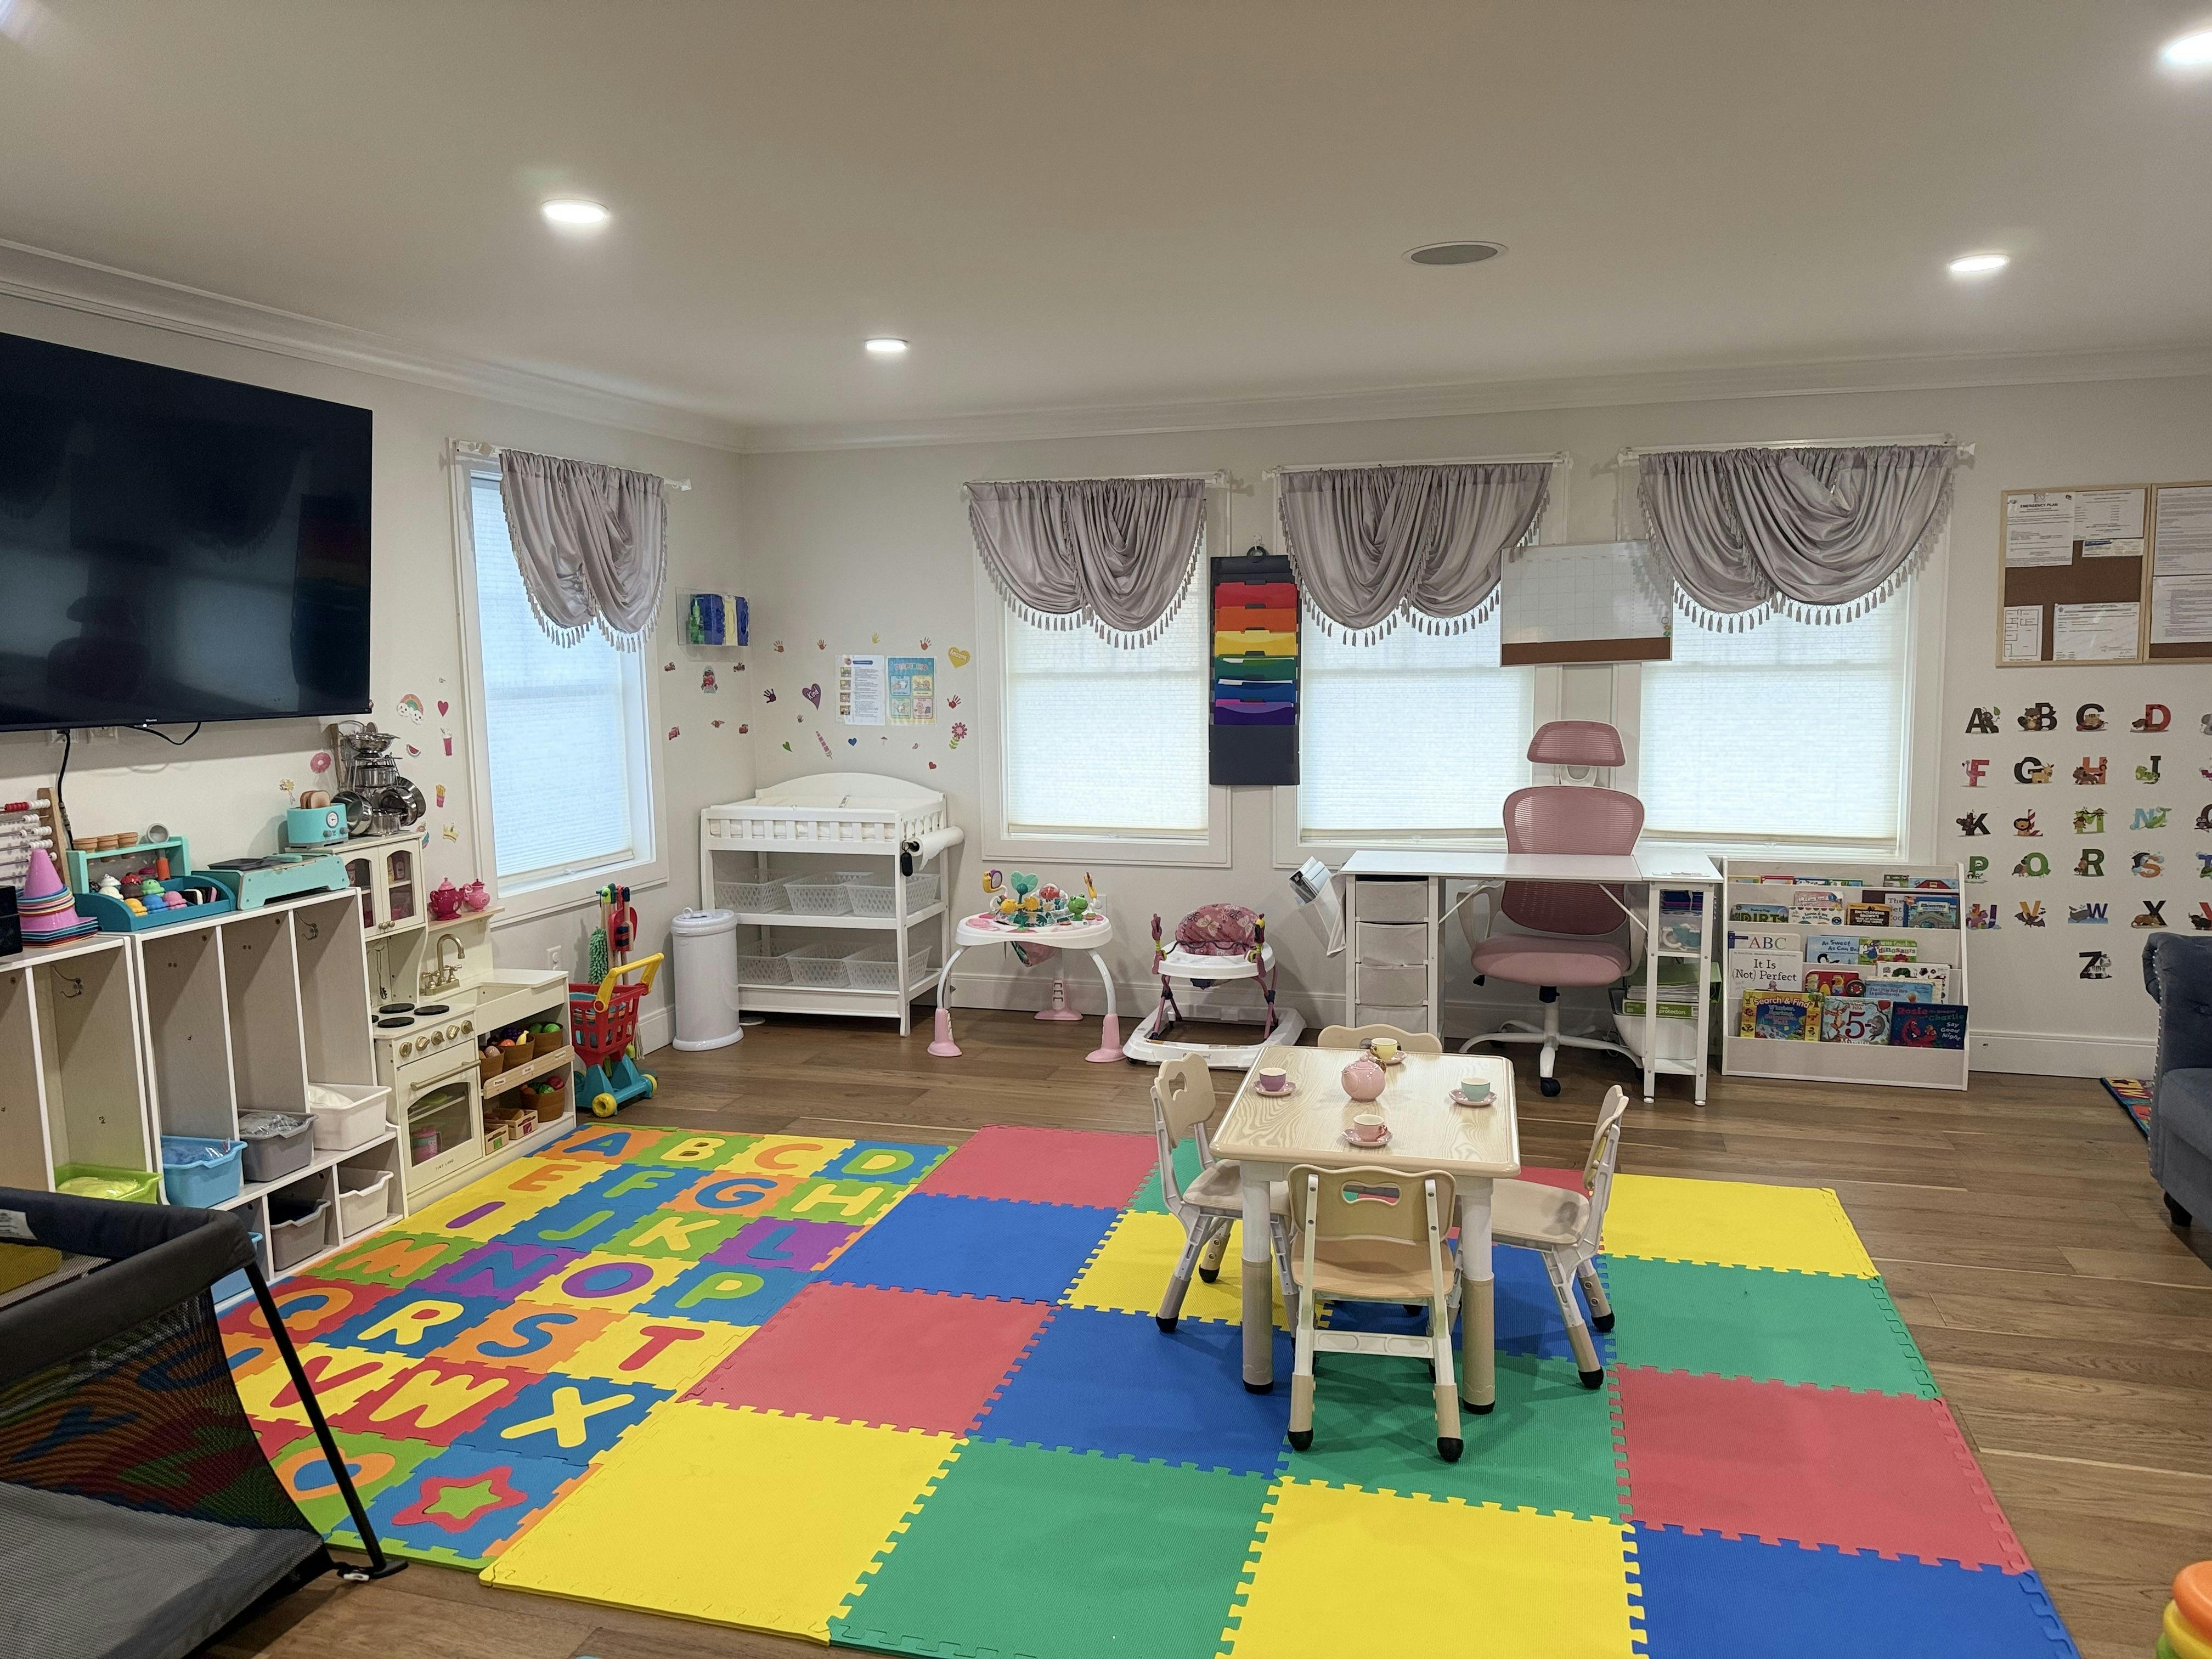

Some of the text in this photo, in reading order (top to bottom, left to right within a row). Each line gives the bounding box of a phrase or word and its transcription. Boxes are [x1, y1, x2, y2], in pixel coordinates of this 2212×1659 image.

[806, 686, 820, 701] Kind
[1965, 703, 2171, 733] A B C D
[1969, 759, 1990, 787] F
[2014, 757, 2042, 784] G
[2083, 757, 2107, 785] H
[1966, 812, 1991, 836] K
[2076, 810, 2104, 833] M
[1969, 856, 1989, 878] P
[2082, 849, 2104, 877] R
[2138, 853, 2165, 878] S
[1741, 913, 1780, 922] DIRT
[2019, 900, 2041, 925] V
[2086, 902, 2108, 919] W
[2142, 900, 2167, 926] X
[1748, 936, 1786, 950] ABC
[1732, 968, 1797, 981] (Not) Perfect
[1754, 959, 1776, 969] It Is
[2079, 951, 2112, 979] Z
[1754, 996, 1782, 1006] Search
[1792, 998, 1810, 1008] Find
[1942, 1032, 1961, 1041] Night
[562, 1131, 915, 1175] A B C D
[507, 1164, 880, 1216] E F G H
[445, 1201, 798, 1261] I J K L
[334, 1238, 765, 1309] M N O P
[248, 1286, 705, 1372] Q R S T
[269, 1356, 384, 1409] V
[369, 1369, 509, 1429] W
[500, 1386, 635, 1448] X
